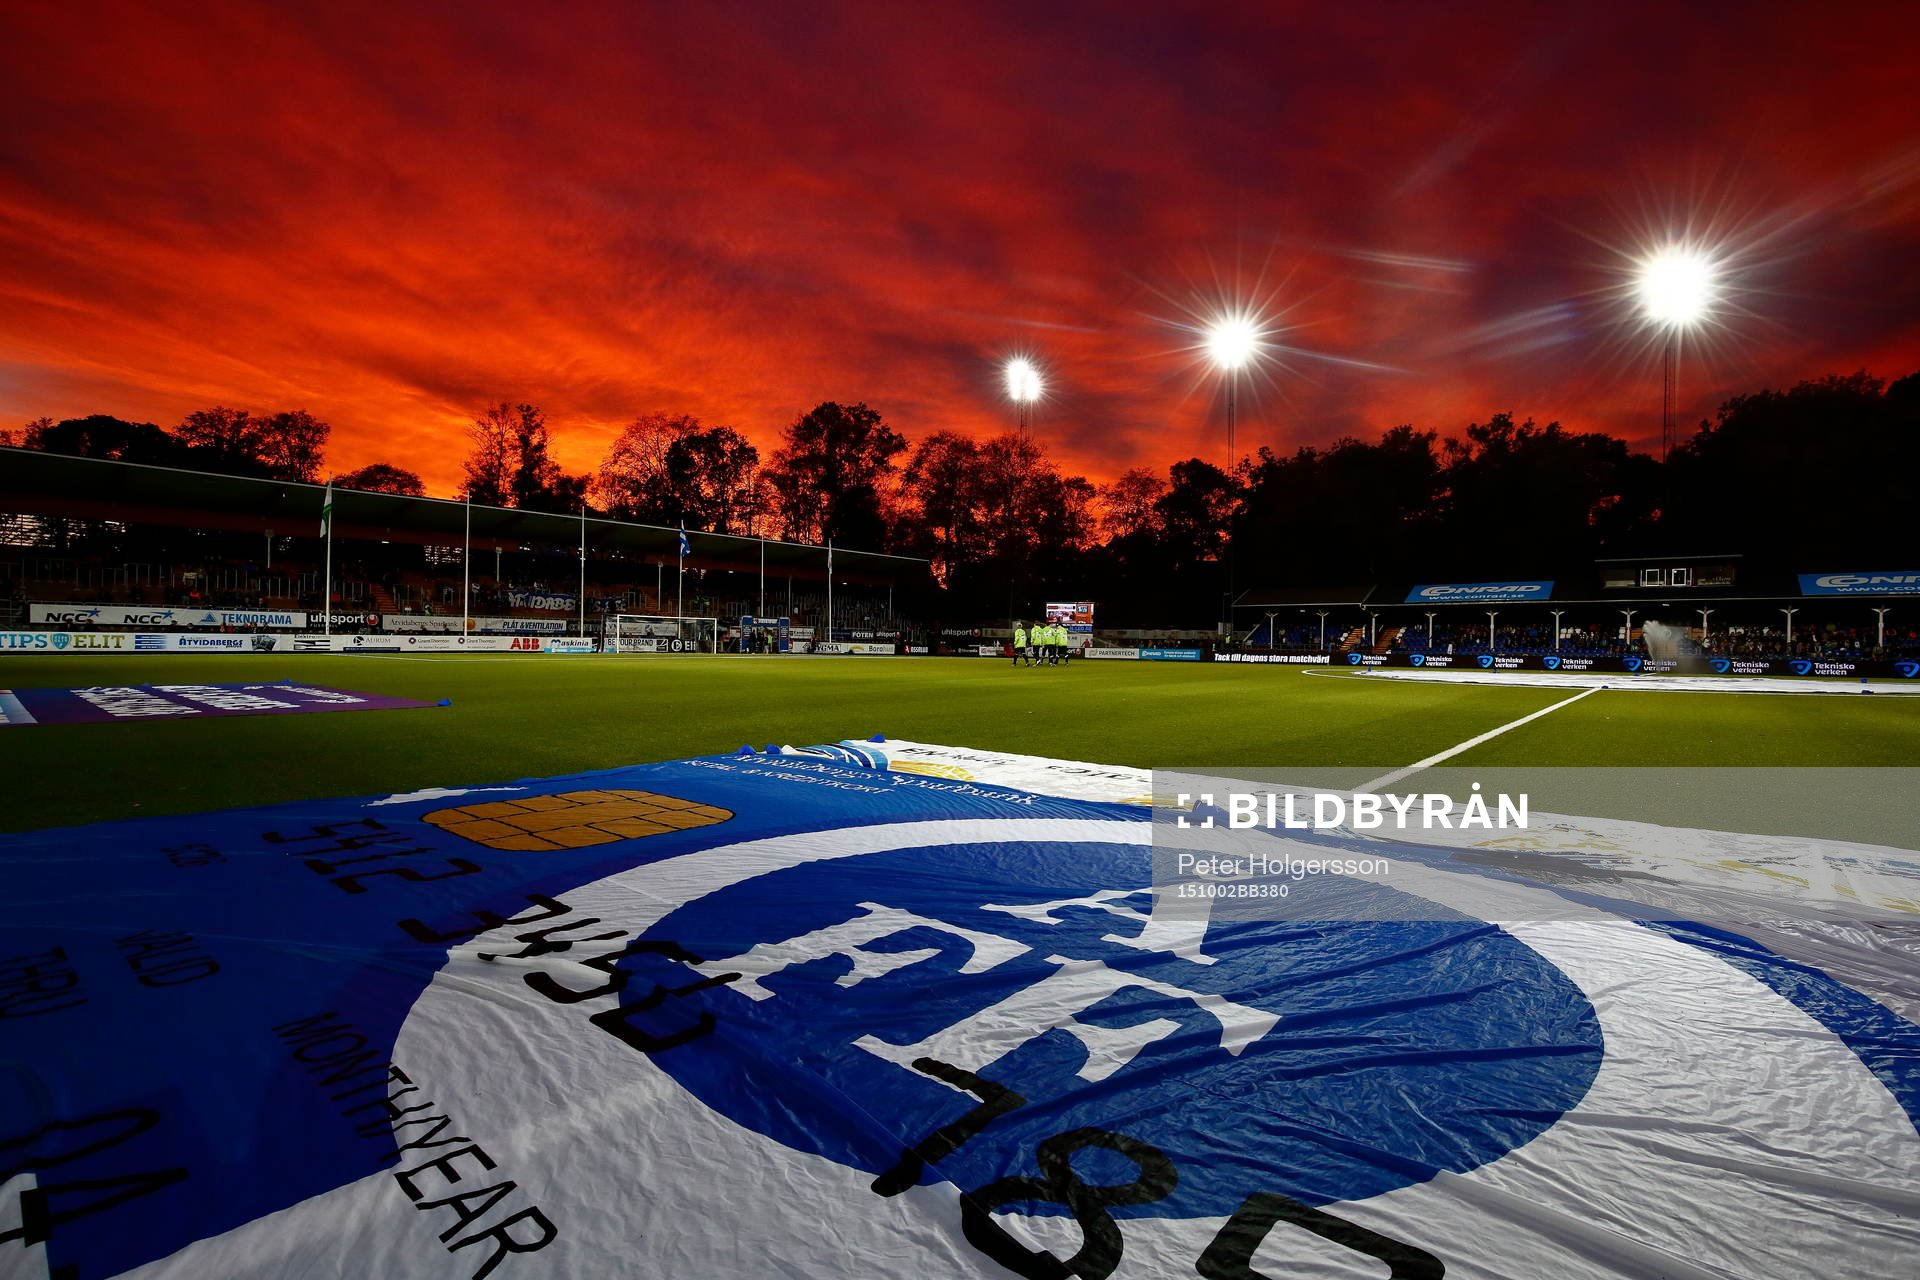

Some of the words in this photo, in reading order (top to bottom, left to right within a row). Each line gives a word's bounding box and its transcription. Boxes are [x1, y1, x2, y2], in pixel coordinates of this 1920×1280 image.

[1420, 585, 1542, 597] CONRAD
[1429, 593, 1525, 601] www.conrad.se
[45, 613, 88, 622] NCC
[123, 614, 162, 624] NCC
[221, 613, 292, 625] TEKNORAMA
[310, 613, 365, 625] uhsport
[941, 628, 972, 637] uhlsport
[73, 634, 125, 648] ELIT
[510, 638, 540, 650] ABB
[1214, 653, 1231, 662] Tack
[1231, 653, 1241, 662] till
[1241, 653, 1268, 663] dagens
[1268, 654, 1288, 663] stora
[1289, 655, 1330, 664] matchvärd
[1814, 662, 1855, 670] Tekniska
[112, 929, 221, 987] VALID
[272, 1011, 559, 1280] MONTH/YEAR
